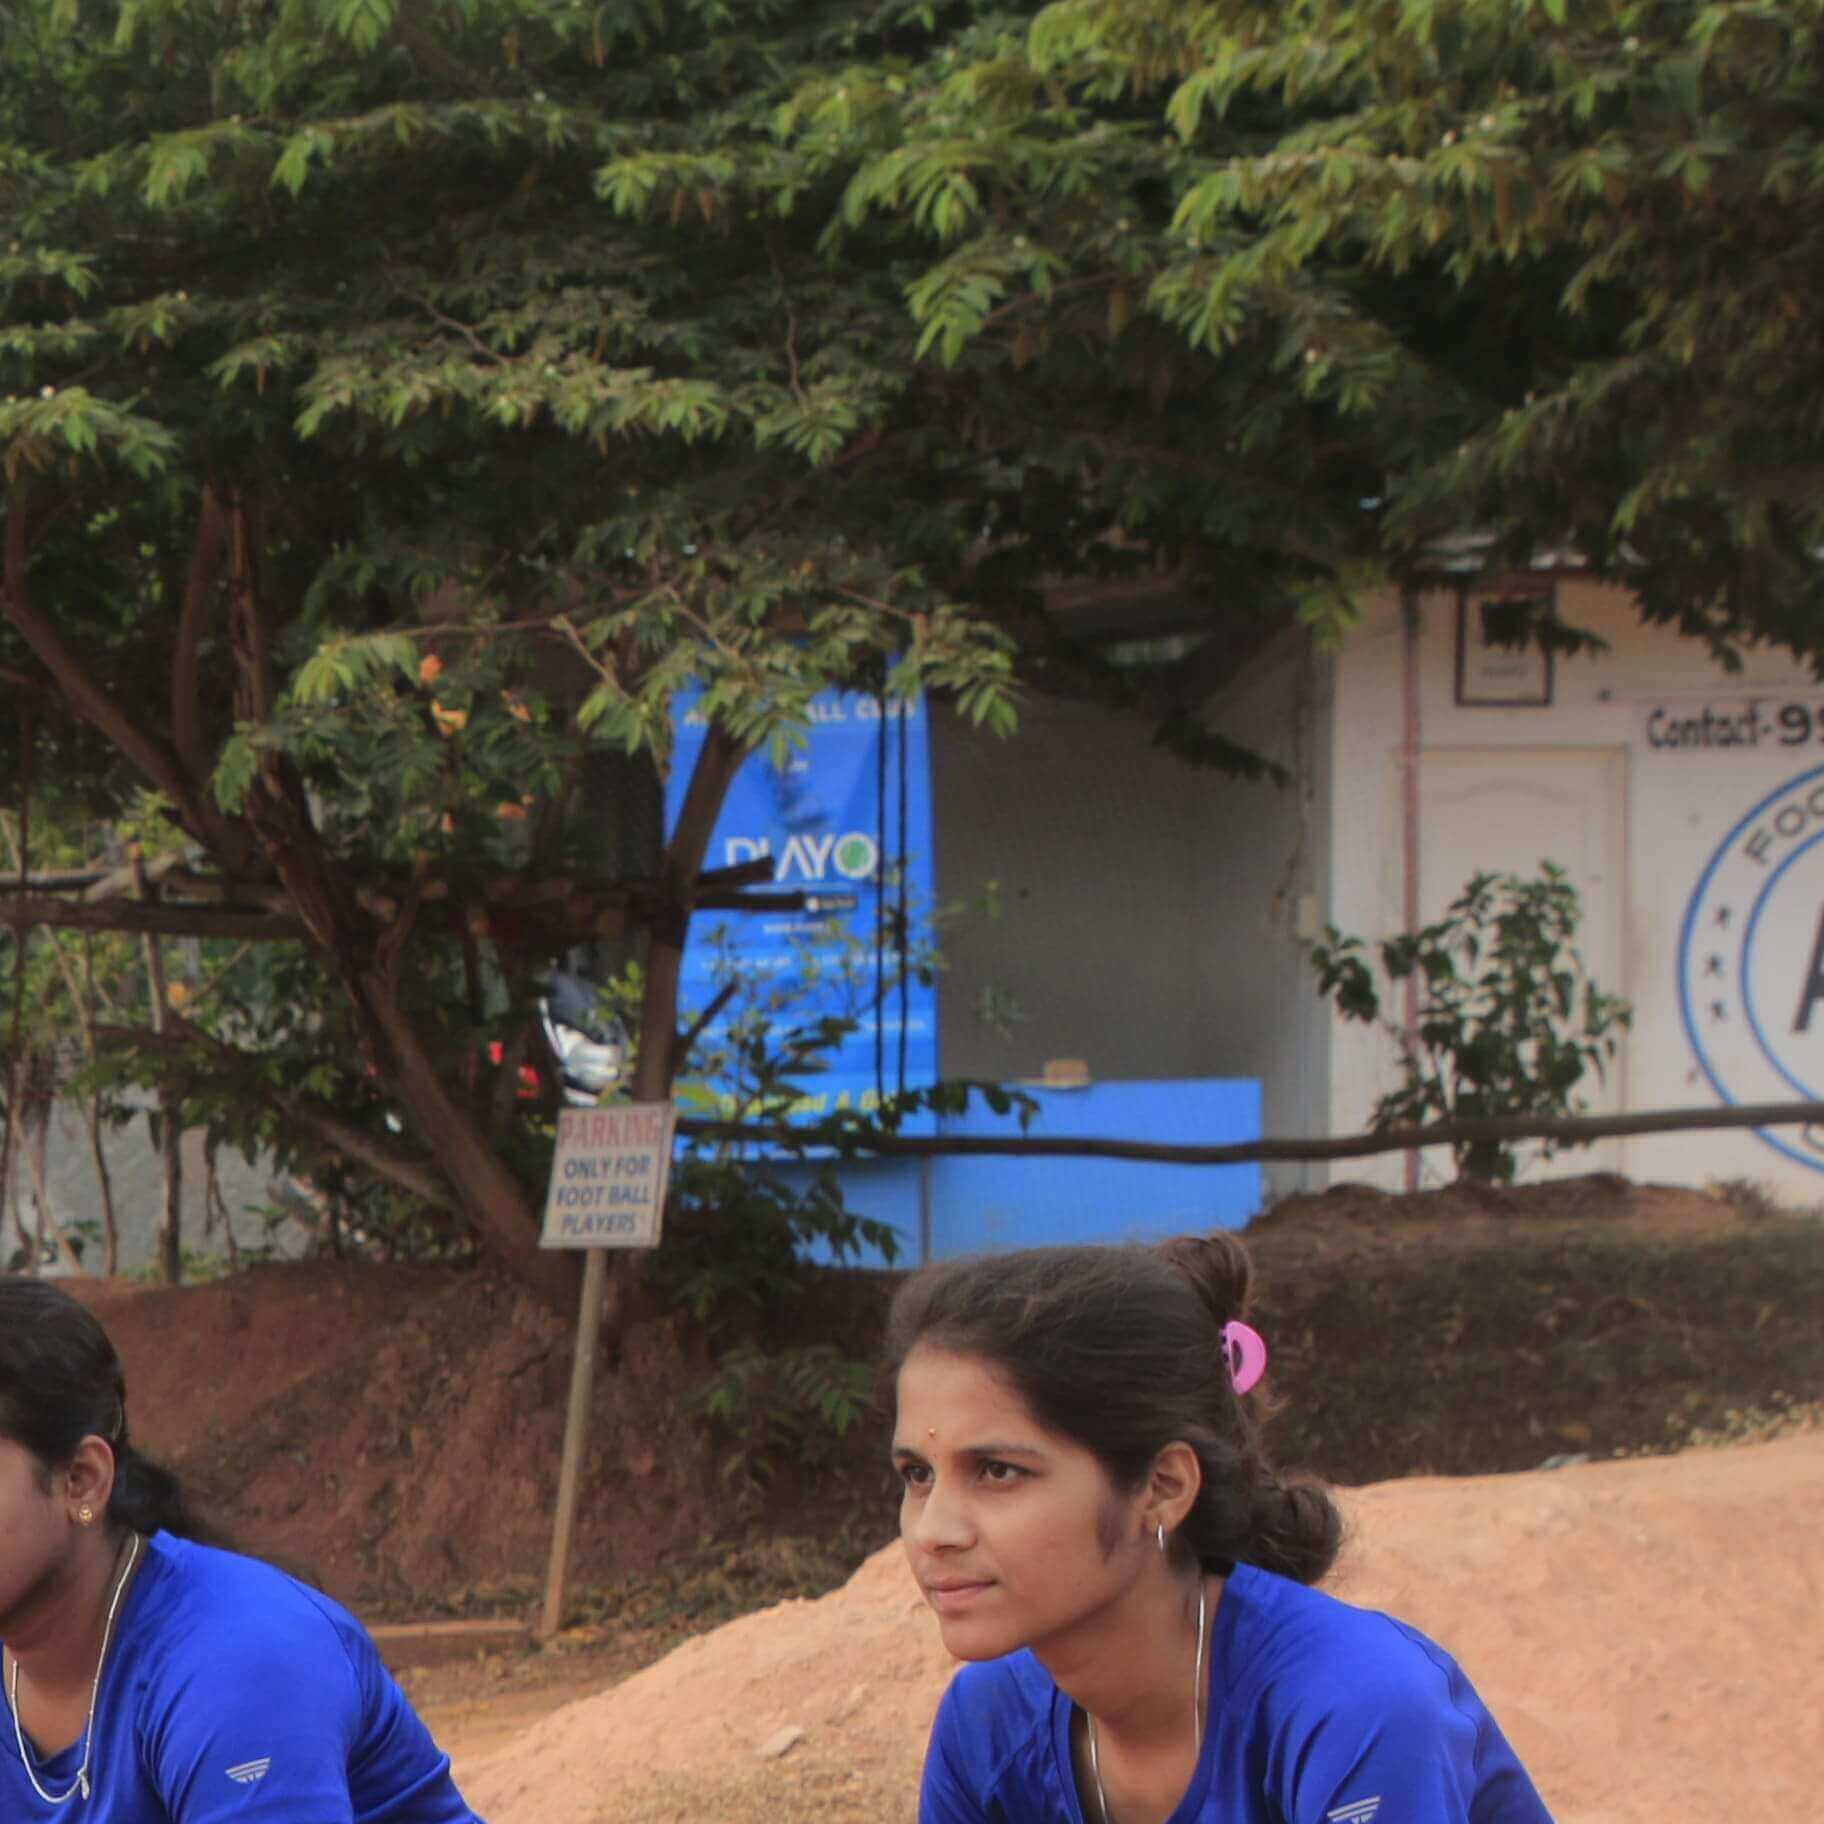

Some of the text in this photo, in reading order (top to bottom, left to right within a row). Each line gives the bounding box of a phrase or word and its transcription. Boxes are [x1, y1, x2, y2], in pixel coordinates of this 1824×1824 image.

[560, 1113, 657, 1147] PARKING
[564, 1153, 652, 1180] ONLY FOR
[557, 1182, 650, 1208] FOOT BALL
[561, 1211, 636, 1235] PLAYERS
